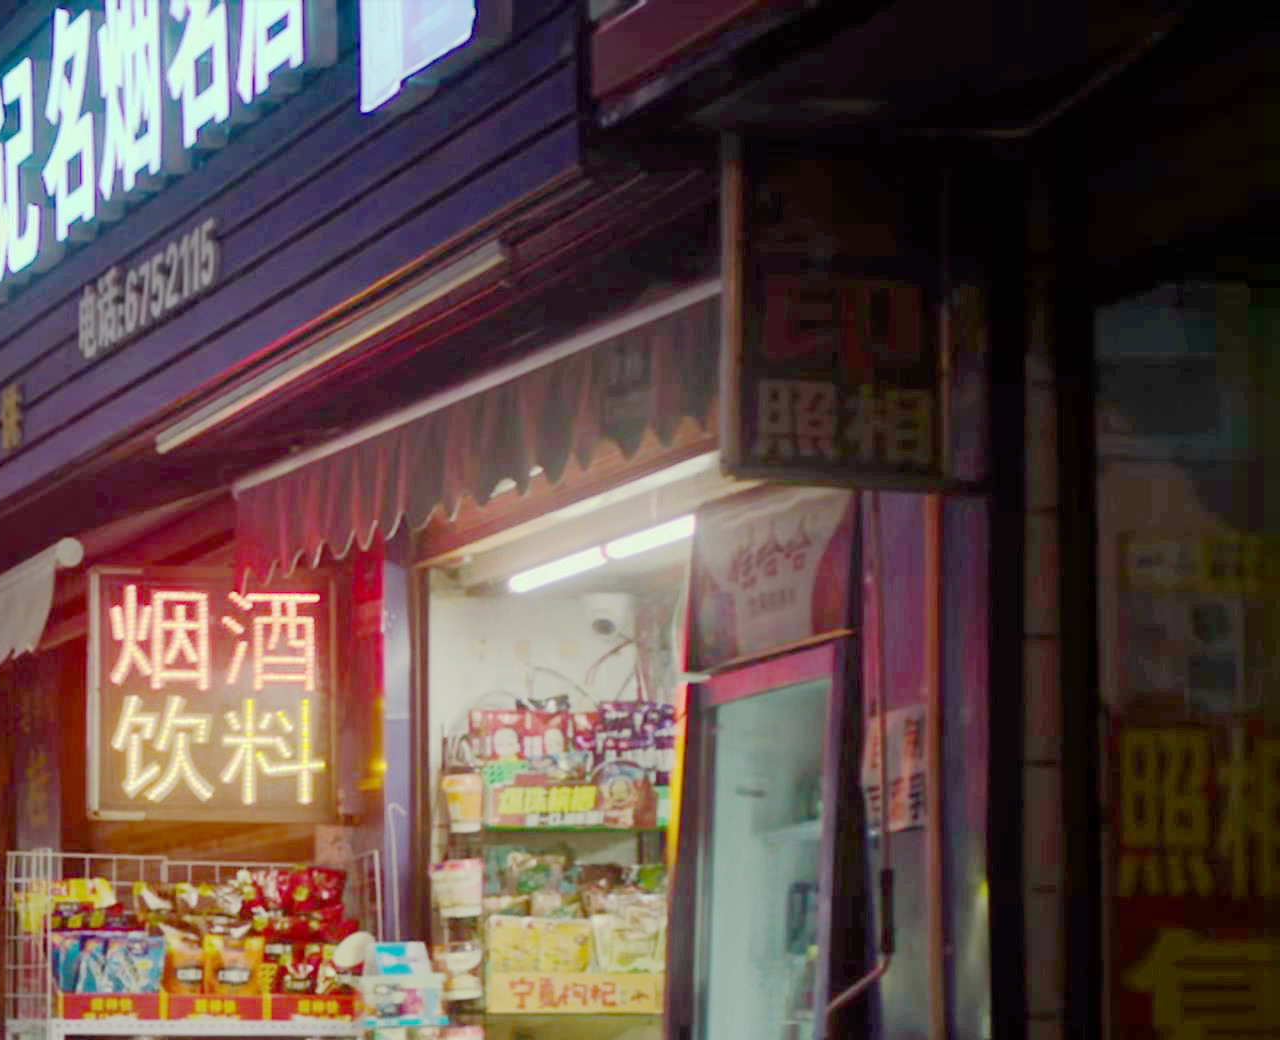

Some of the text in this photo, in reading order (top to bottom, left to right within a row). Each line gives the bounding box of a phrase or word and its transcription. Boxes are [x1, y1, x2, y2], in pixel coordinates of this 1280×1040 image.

[759, 379, 930, 460] 照相
[108, 584, 322, 692] 烟酒
[110, 694, 326, 806] 饮料
